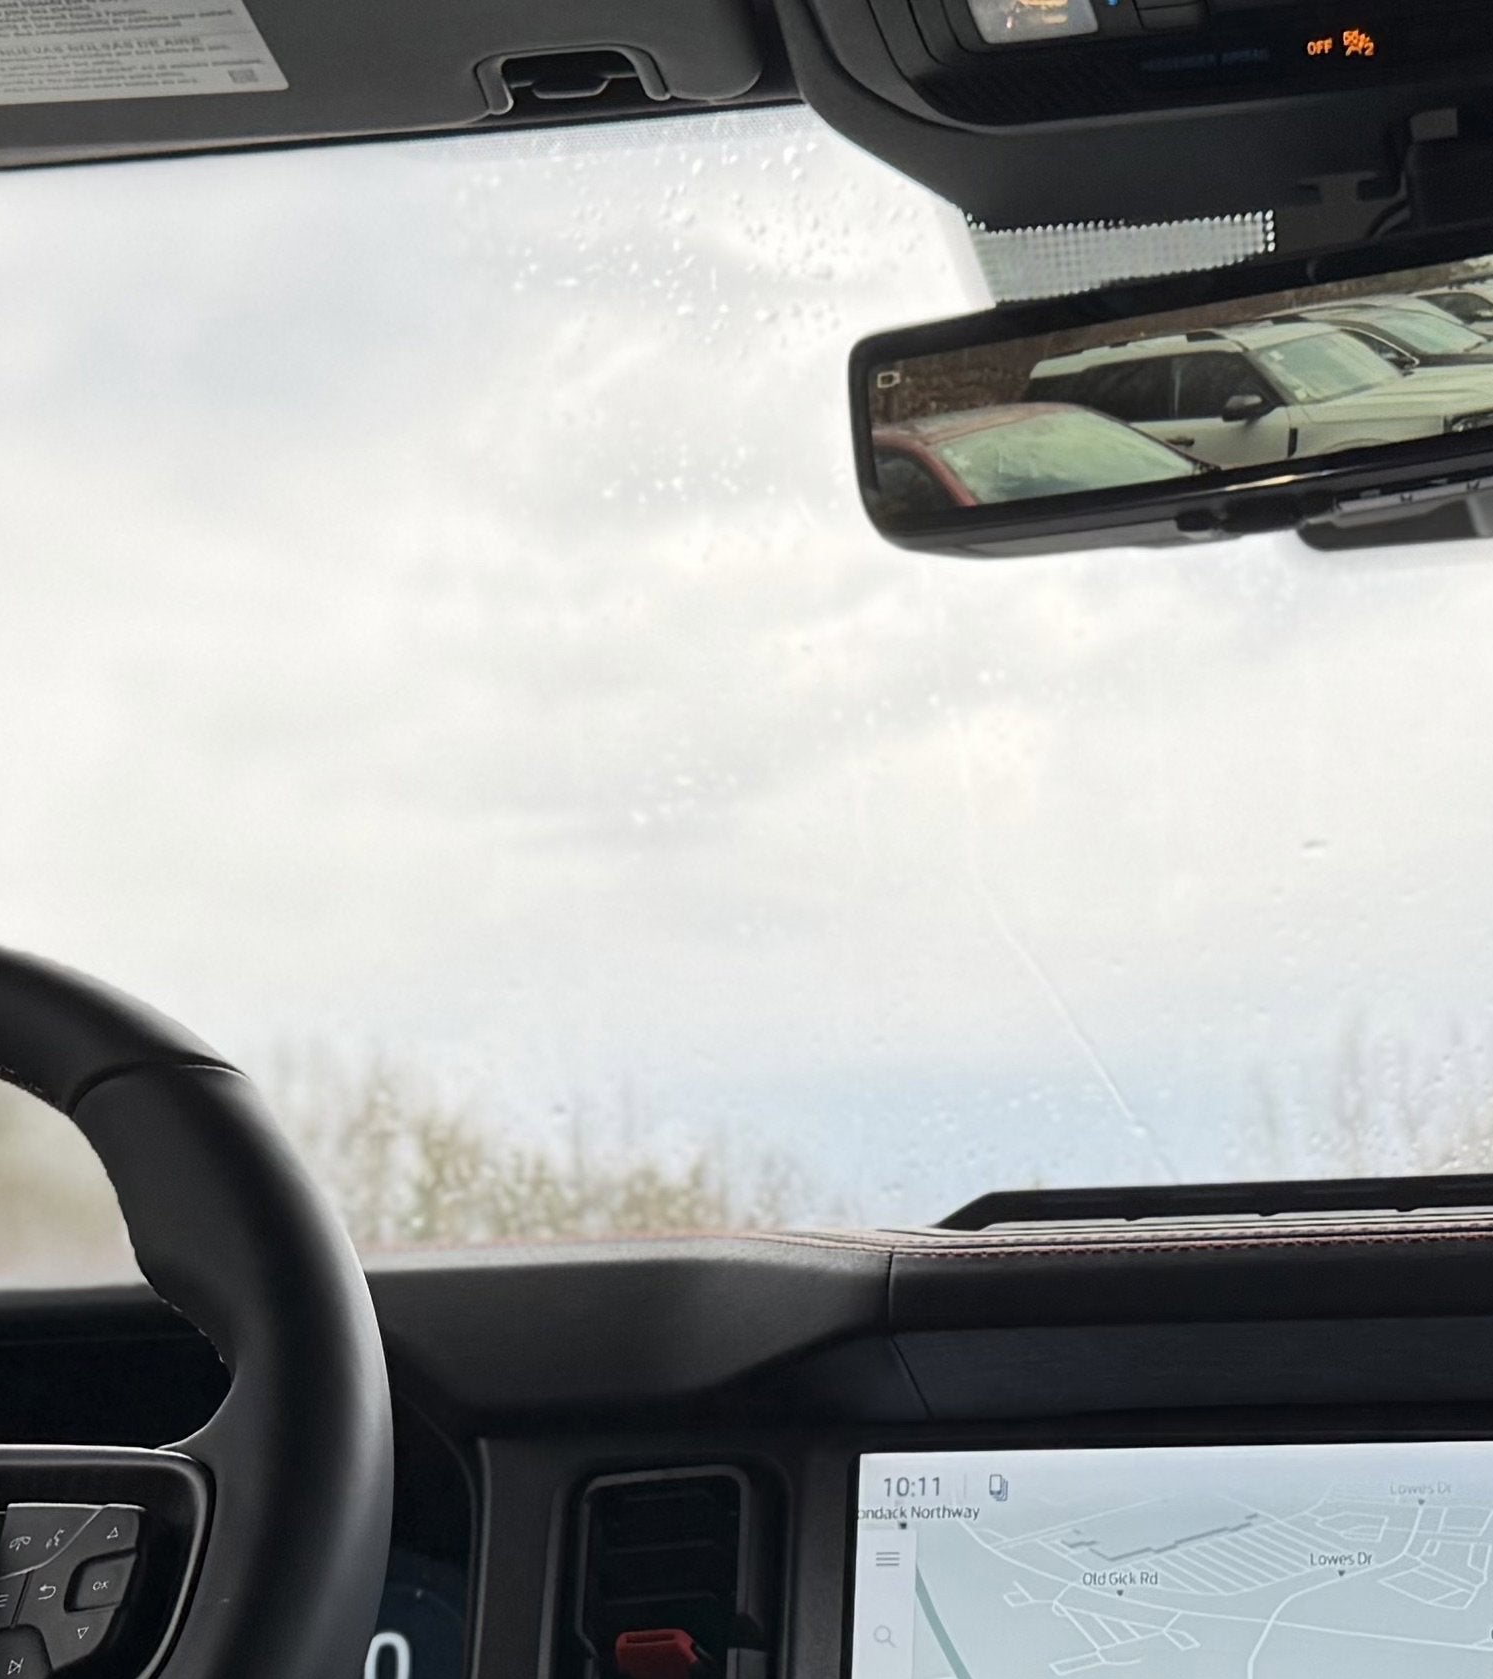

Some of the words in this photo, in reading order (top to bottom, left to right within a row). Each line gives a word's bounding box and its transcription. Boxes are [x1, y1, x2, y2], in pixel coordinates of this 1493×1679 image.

[1307, 38, 1333, 57] OFF
[884, 1477, 940, 1497] 10:11
[911, 1505, 980, 1521] Northway
[1310, 1551, 1354, 1567] Lowes
[1358, 1551, 1373, 1566] Dr
[1083, 1571, 1106, 1587] Old
[1141, 1571, 1159, 1586] Rd
